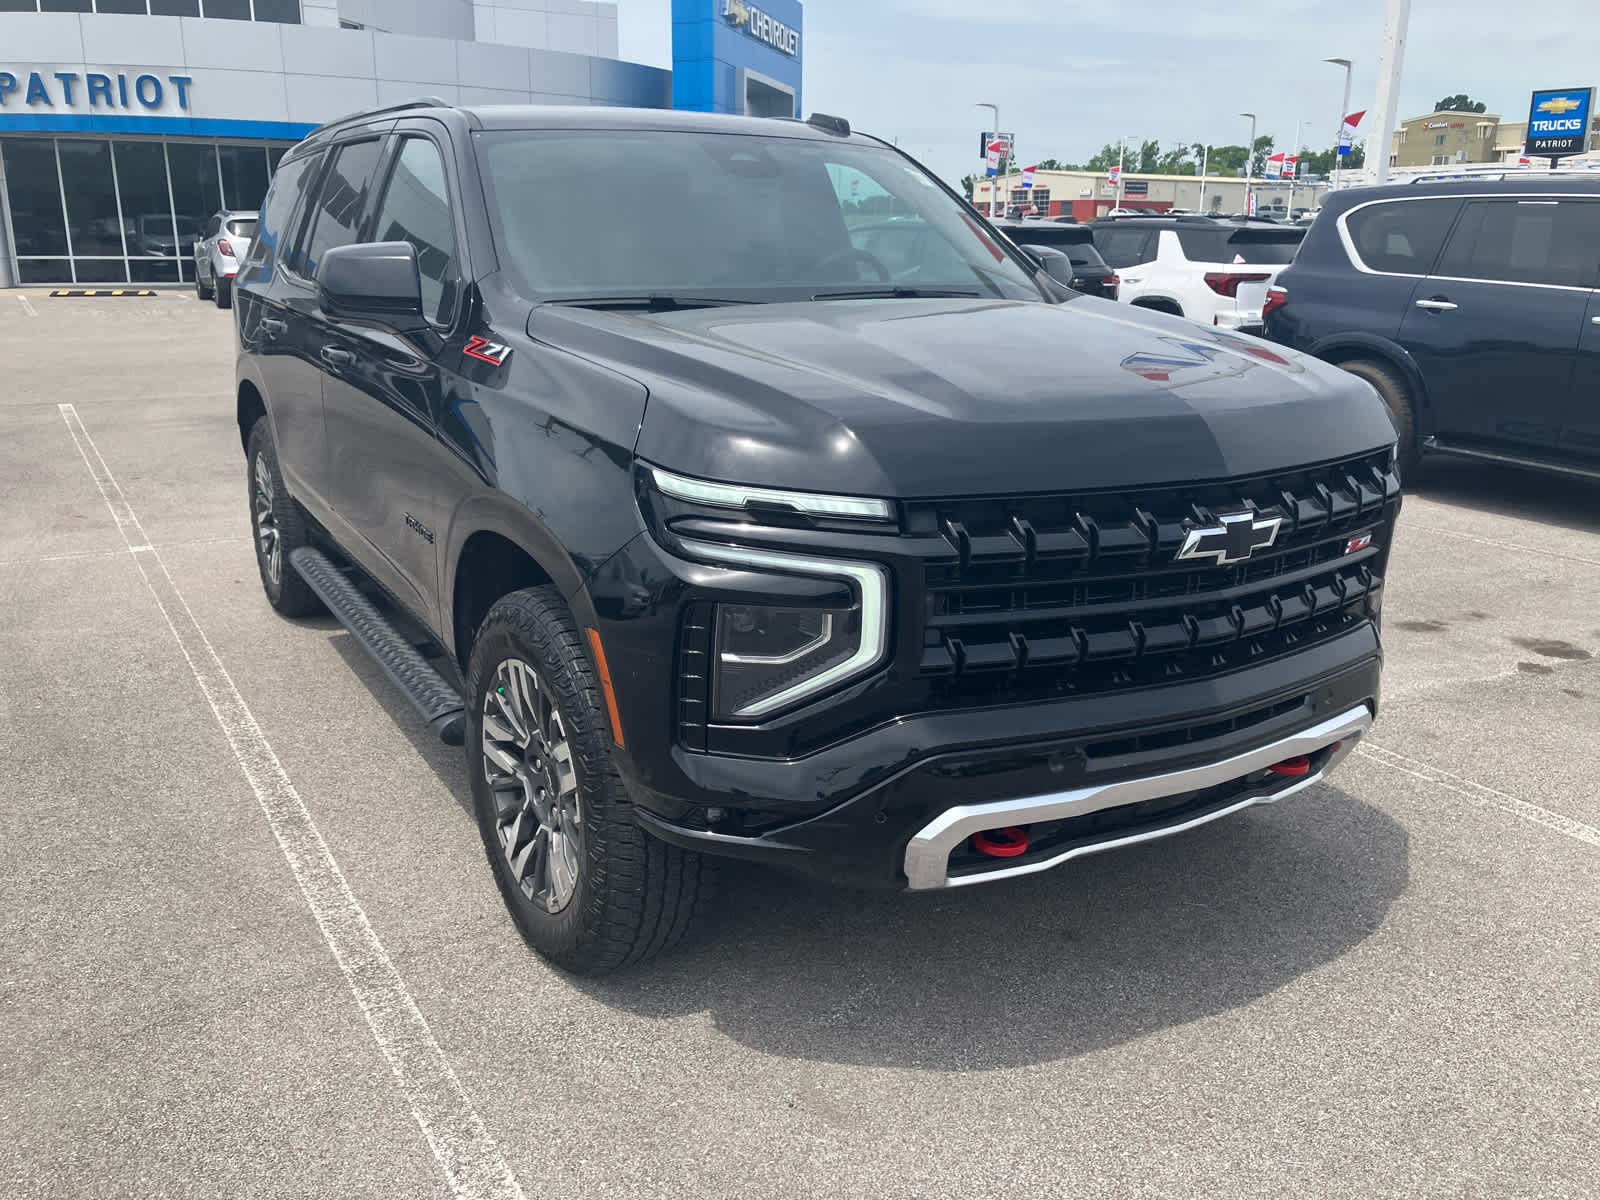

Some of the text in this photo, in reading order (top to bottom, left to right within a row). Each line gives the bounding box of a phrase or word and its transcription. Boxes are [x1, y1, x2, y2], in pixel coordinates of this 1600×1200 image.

[750, 6, 800, 57] CHEVROLET
[0, 72, 192, 109] PATRIOT
[1532, 119, 1582, 132] TRUCKS
[1535, 139, 1573, 148] PATRIOT
[463, 335, 512, 366] Z71
